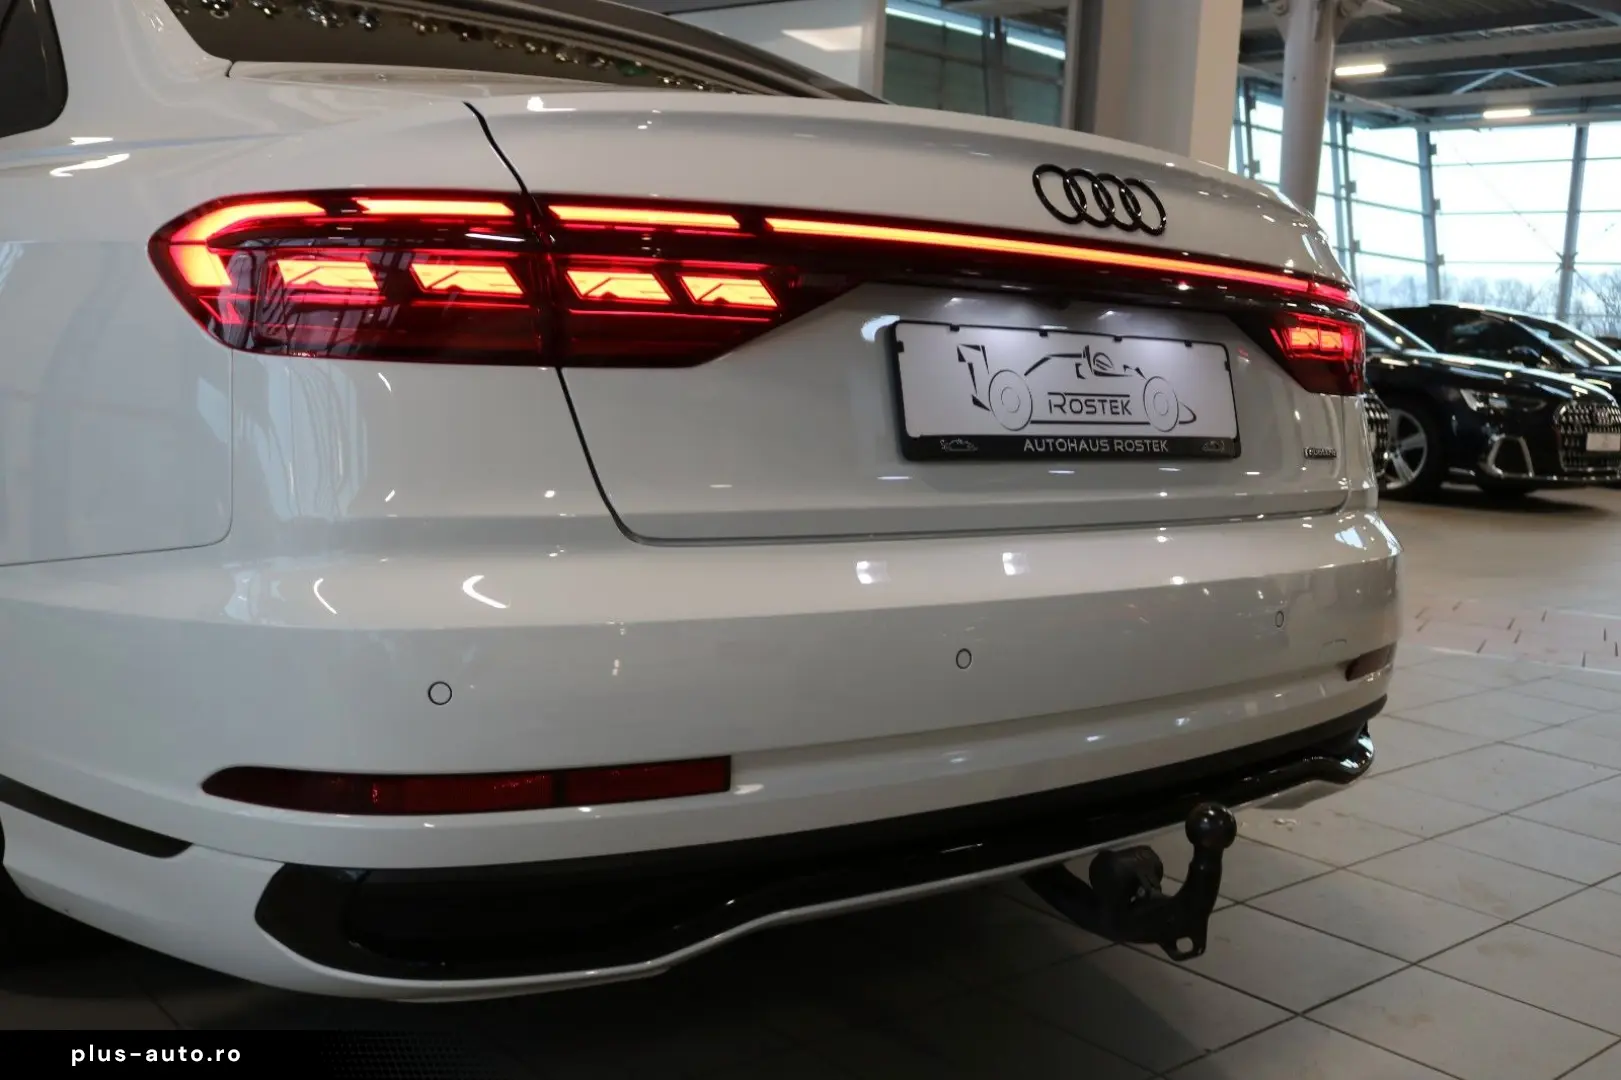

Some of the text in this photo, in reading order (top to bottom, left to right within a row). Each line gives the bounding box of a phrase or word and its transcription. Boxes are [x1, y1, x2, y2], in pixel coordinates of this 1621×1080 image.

[1048, 392, 1132, 415] ROSTEK
[1023, 438, 1169, 453] AUTOHAUS ROSTEK
